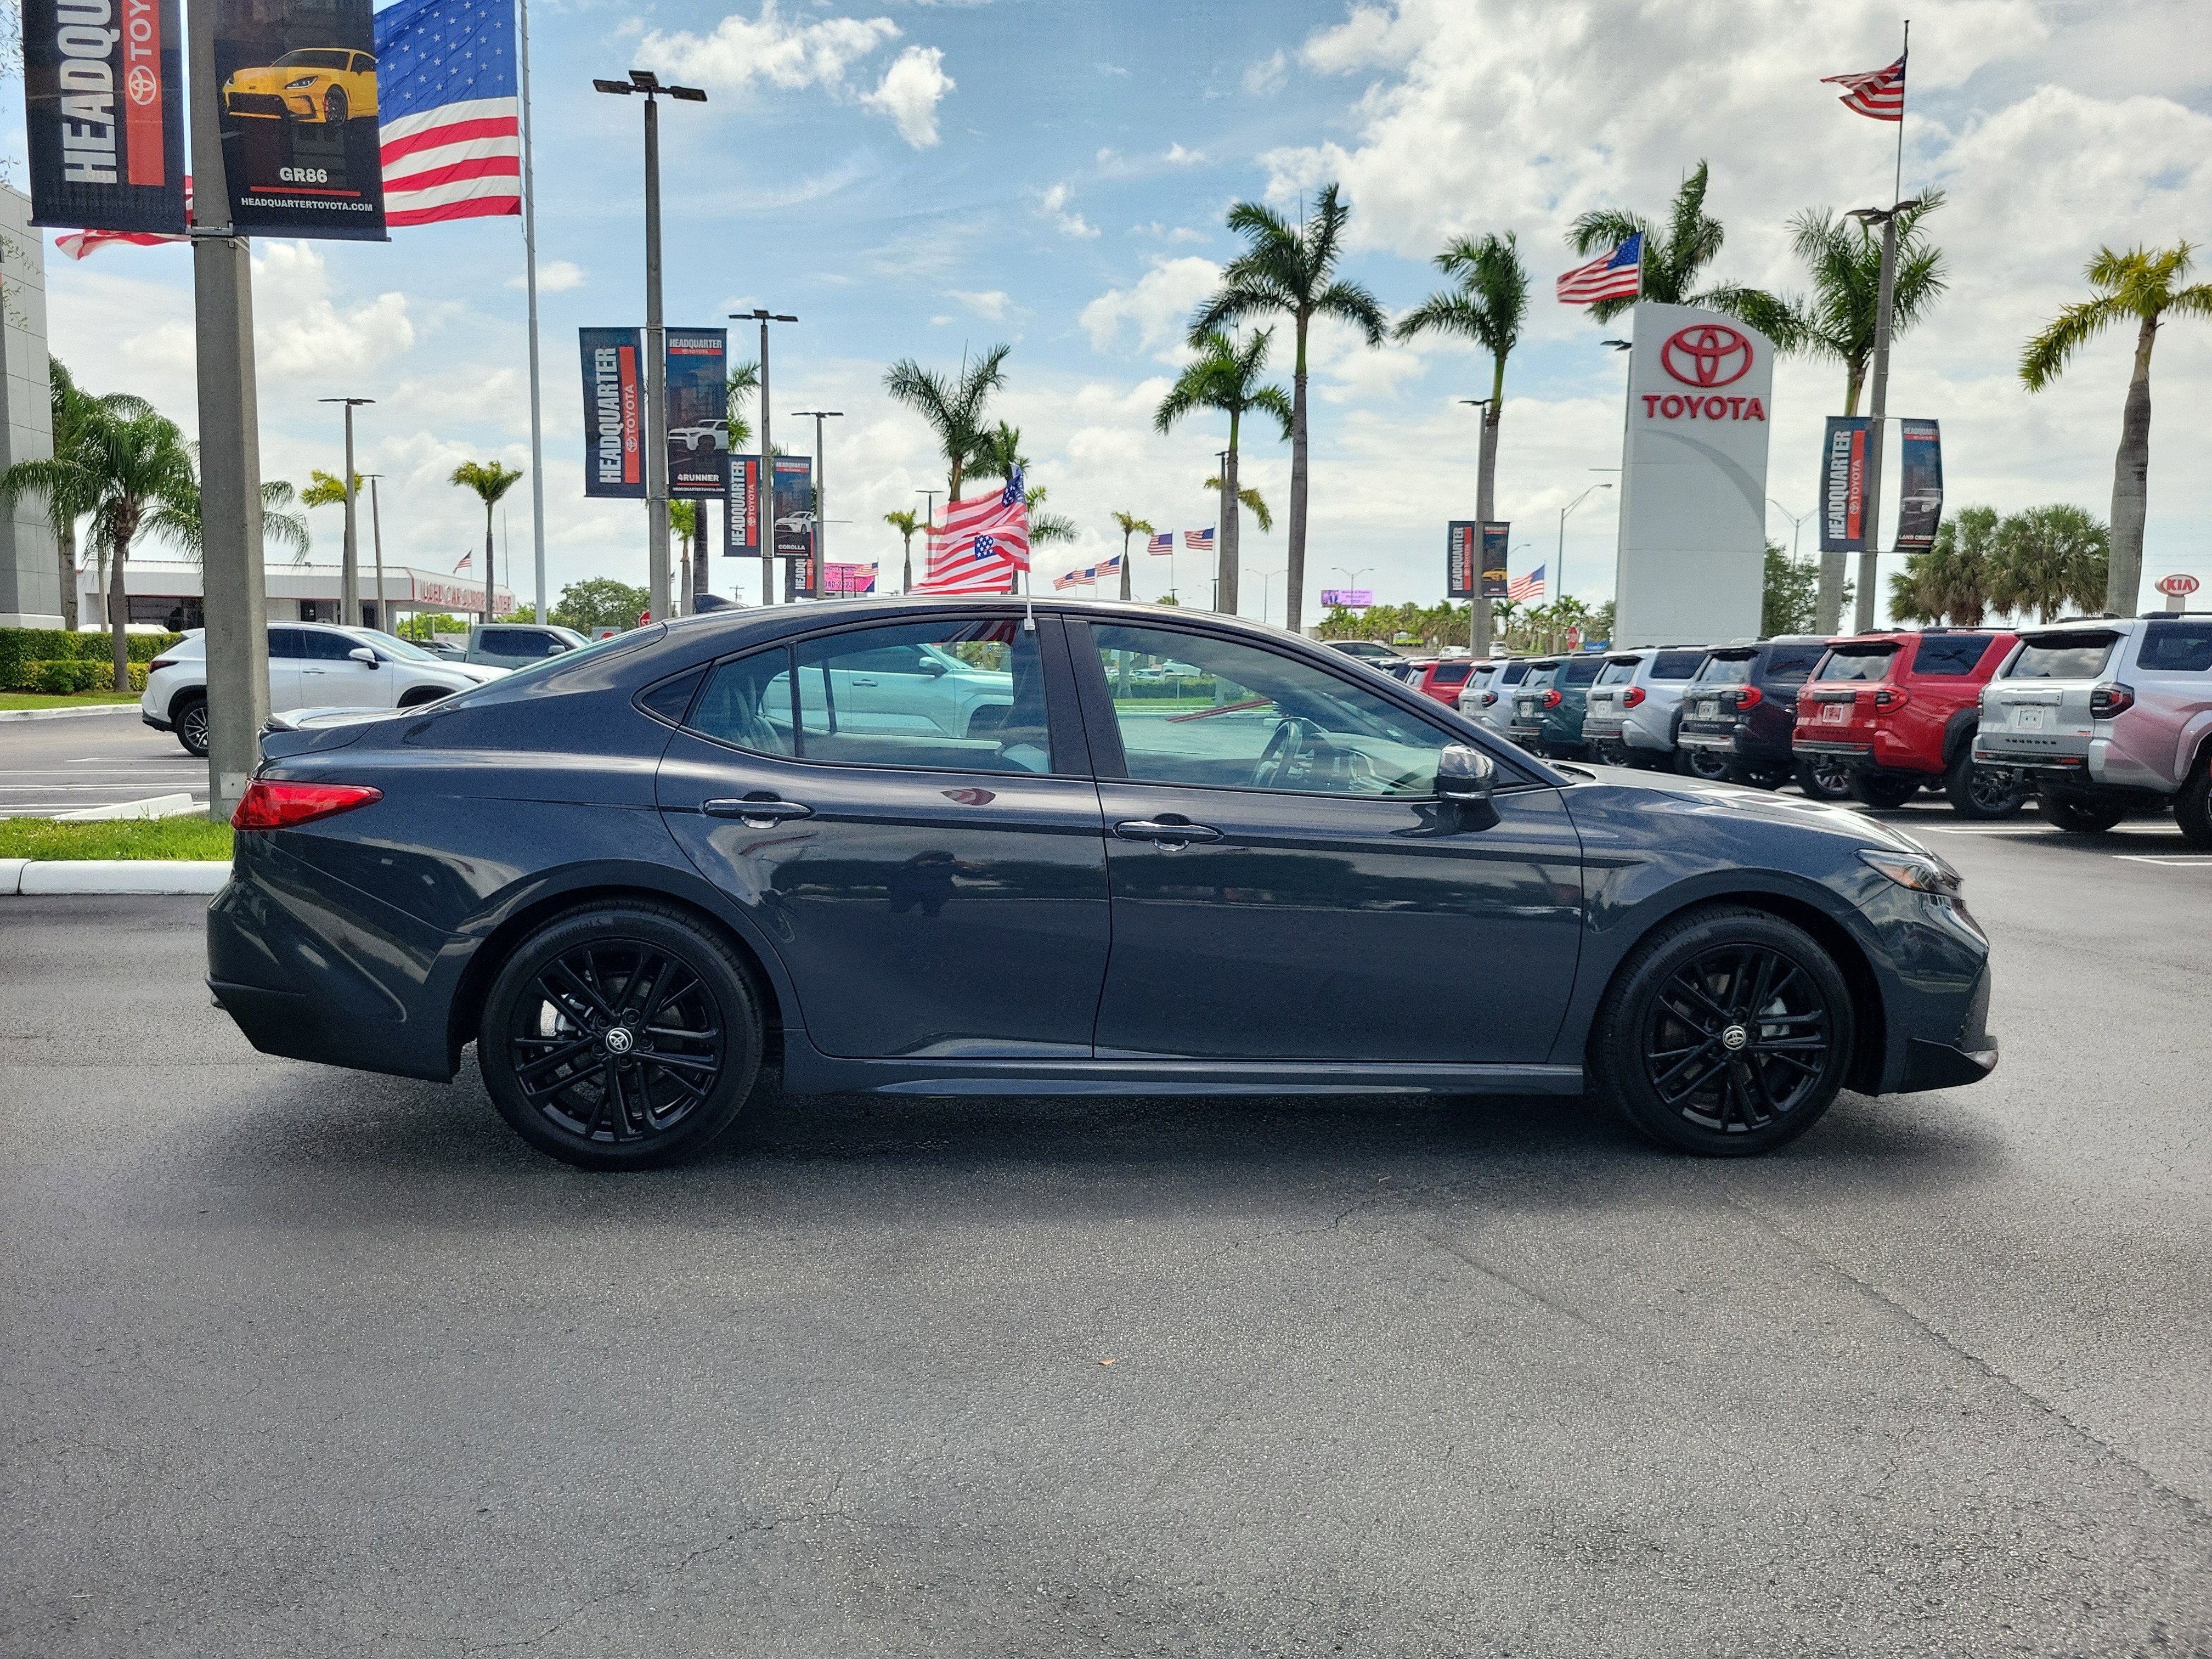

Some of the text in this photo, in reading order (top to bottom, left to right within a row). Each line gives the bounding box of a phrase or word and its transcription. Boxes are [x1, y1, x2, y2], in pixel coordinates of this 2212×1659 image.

[280, 167, 328, 183] GR86
[241, 198, 373, 212] HEADQUARTERTOYOTA.COM
[669, 338, 723, 349] HEADQUARTER
[594, 348, 624, 483] HEADQUARTER
[625, 384, 636, 435] TOYOTA
[1642, 395, 1765, 421] TOYOTA
[677, 473, 719, 482] 4RUNNER
[1828, 430, 1852, 539] HEADQUARTER
[1850, 460, 1861, 501] TOYOTA
[731, 461, 747, 546] HEADQUARTER
[1452, 527, 1464, 591] HEADQUARTER
[423, 580, 443, 602] USED
[2166, 579, 2193, 591] KIA
